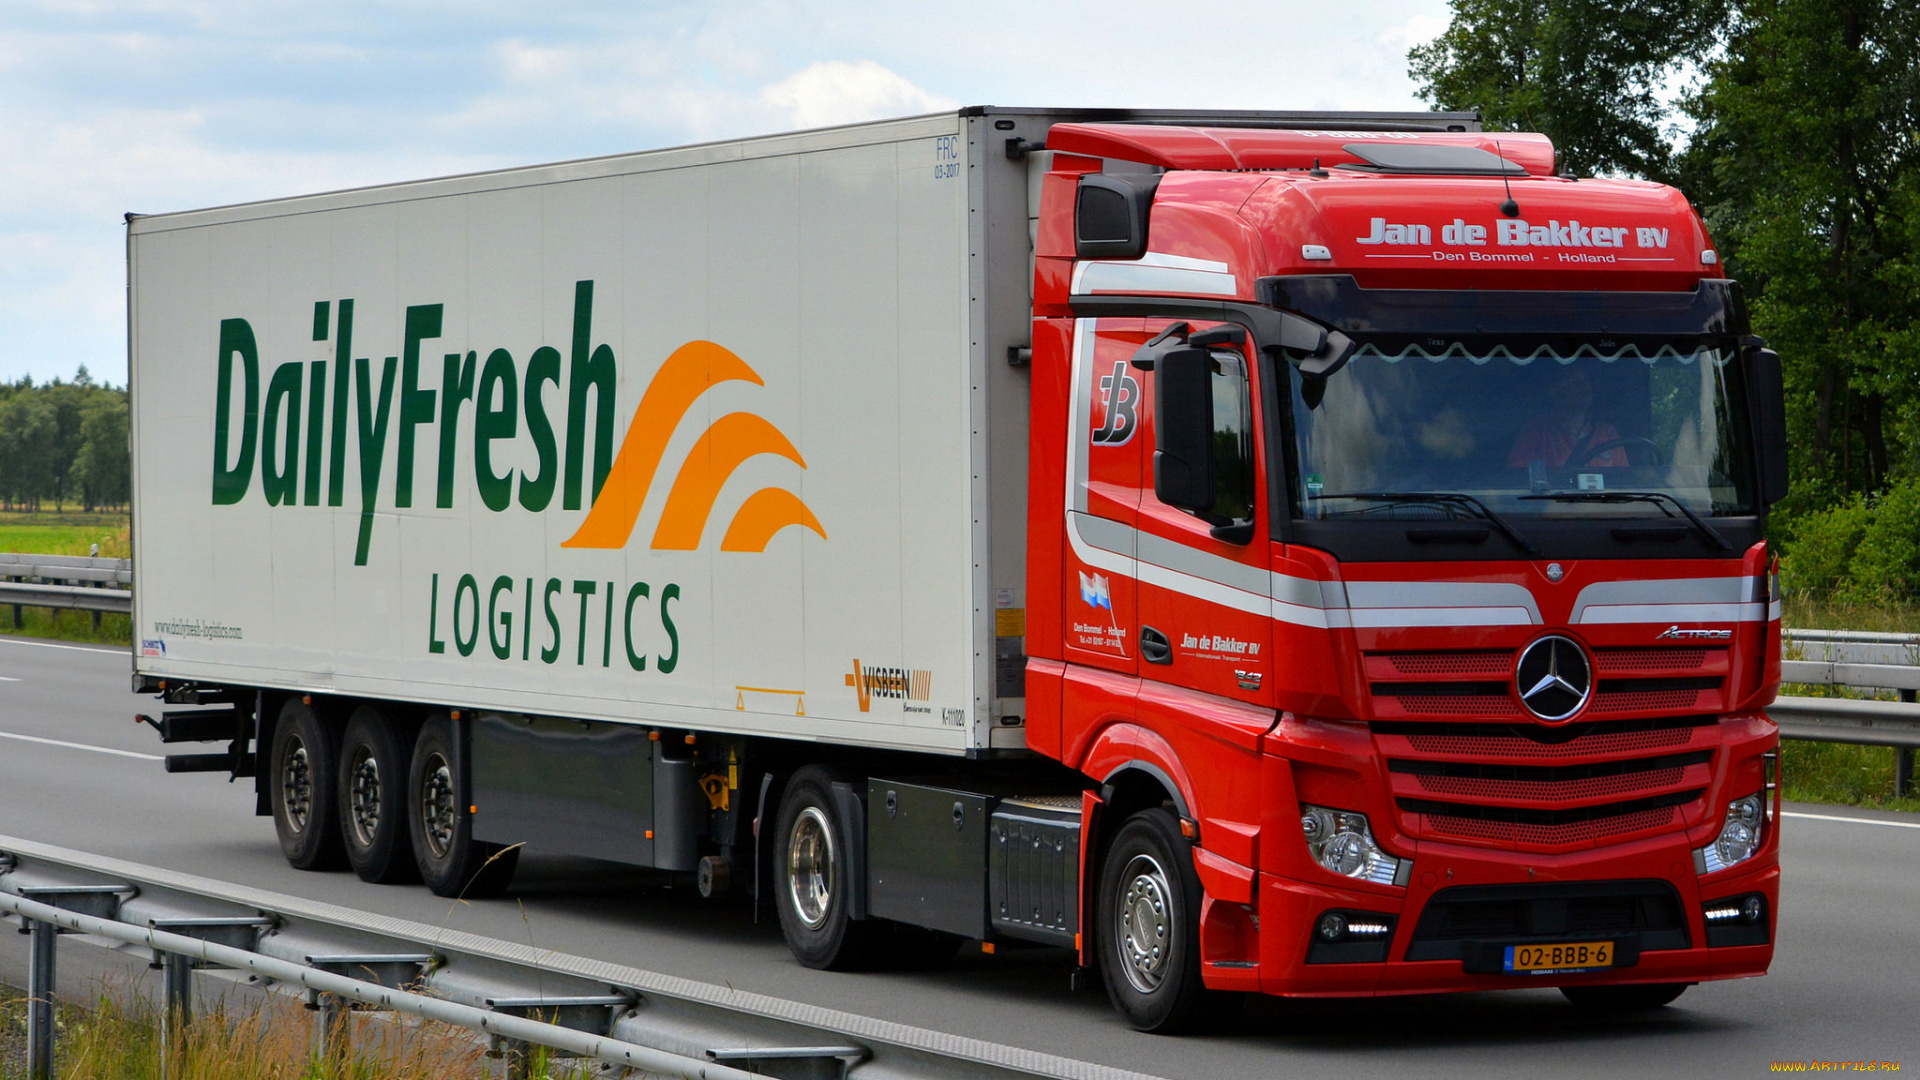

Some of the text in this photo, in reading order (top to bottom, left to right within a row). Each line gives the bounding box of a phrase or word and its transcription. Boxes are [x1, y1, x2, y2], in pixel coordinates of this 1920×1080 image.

[936, 136, 958, 161] FRC
[935, 162, 960, 179] 03-2017
[1356, 217, 1669, 248] Jan de Bakker BV
[1433, 251, 1465, 261] Den
[1469, 252, 1534, 262] Bommel
[1558, 253, 1616, 263] Holland
[212, 280, 618, 566] DailyFresh
[428, 573, 681, 674] LOGISTICS
[1073, 622, 1083, 632] Den
[1083, 623, 1103, 634] Bommel
[1181, 632, 1261, 655] Jan de Bakker BV
[863, 666, 910, 700] VISBEEN
[941, 707, 965, 727] K-111020
[1519, 945, 1607, 966] 02-BBB-6
